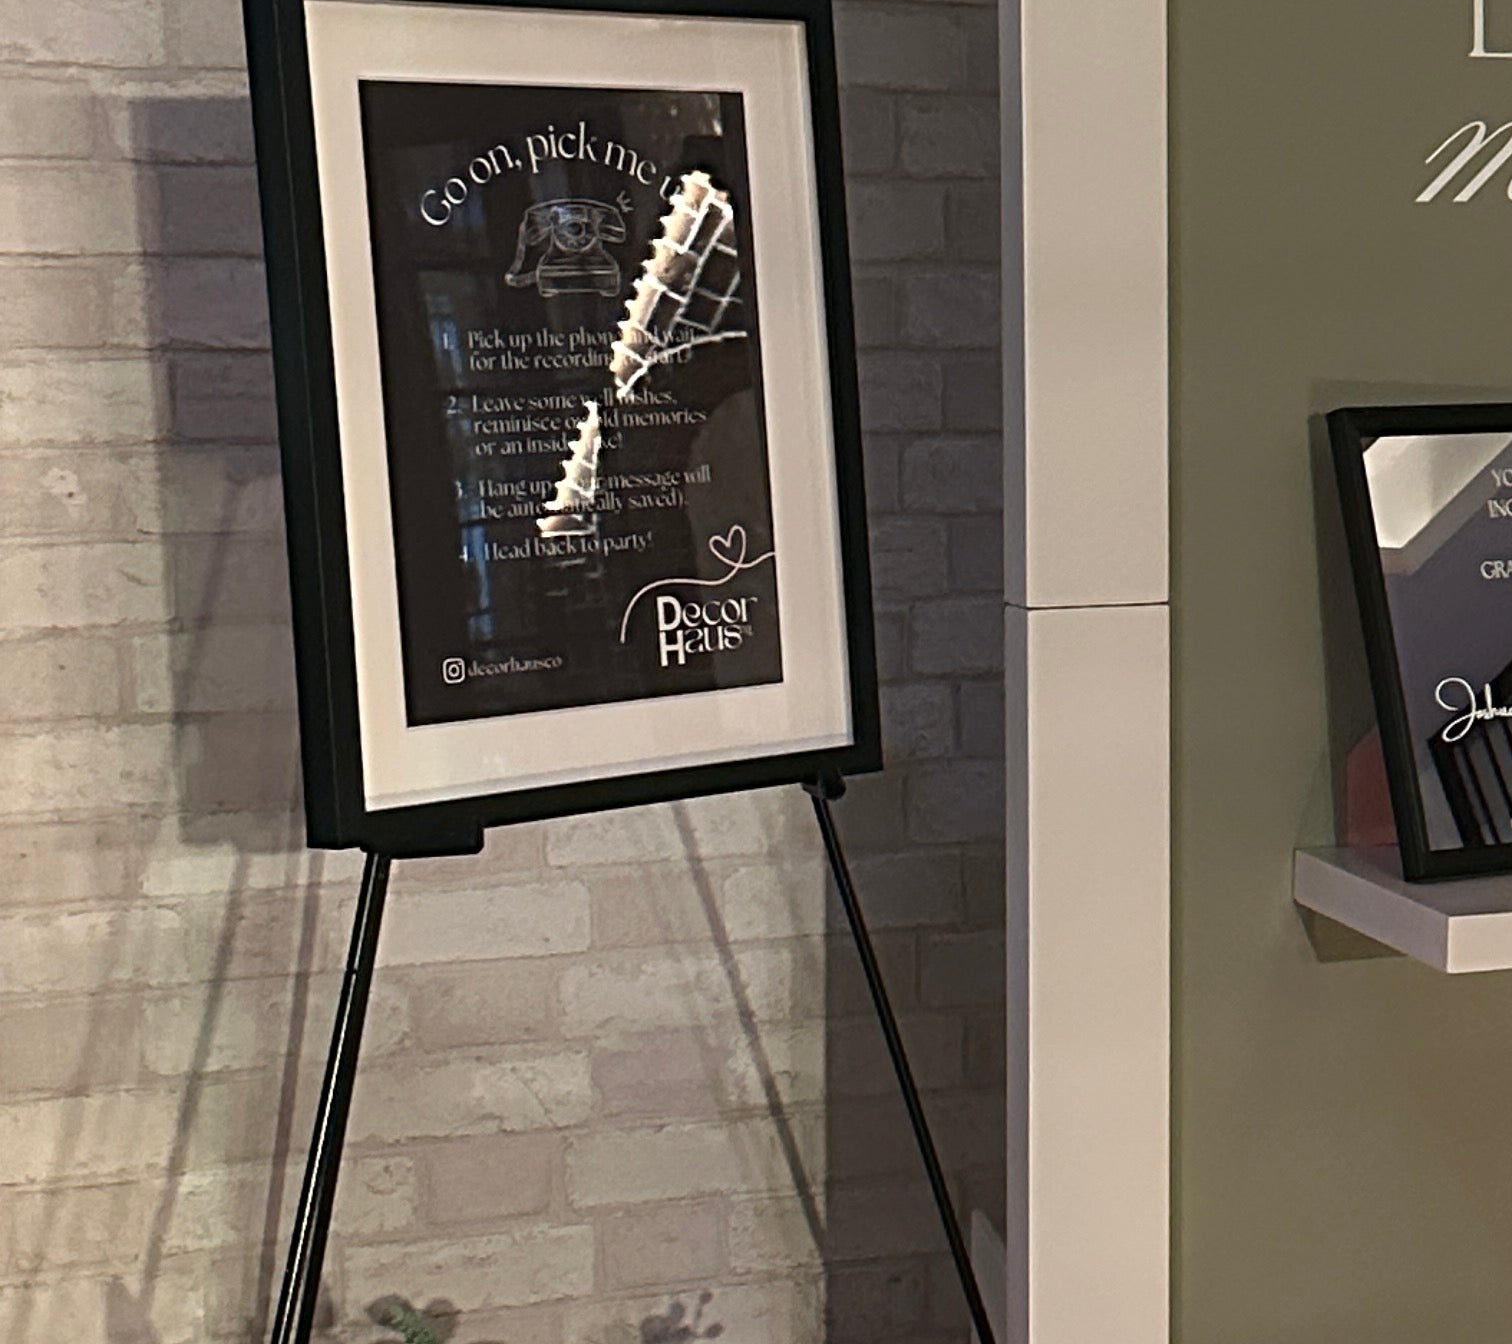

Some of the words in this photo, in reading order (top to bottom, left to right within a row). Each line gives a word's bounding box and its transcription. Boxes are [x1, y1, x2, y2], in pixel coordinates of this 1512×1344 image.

[420, 177, 468, 226] Go
[468, 144, 522, 184] on,
[525, 121, 597, 173] pick
[604, 140, 657, 186] me
[468, 328, 505, 349] Pick
[508, 334, 531, 353] up
[536, 327, 564, 347] the
[568, 326, 620, 352] phon
[470, 350, 496, 370] for
[501, 350, 530, 369] the
[533, 347, 621, 368] recordin
[472, 394, 524, 412] Leave
[527, 393, 577, 411] some
[473, 415, 561, 434] reminisce
[623, 408, 707, 427] memories
[475, 441, 496, 455] or
[500, 440, 523, 455] an
[526, 432, 577, 453] insid
[479, 479, 528, 502] Hang
[529, 479, 552, 500] up
[608, 470, 681, 489] message
[683, 464, 712, 484] will
[481, 499, 503, 519] be
[484, 537, 531, 560] Head
[533, 536, 577, 557] back
[581, 536, 598, 554] to
[600, 531, 653, 557] party!
[656, 595, 758, 631] Decor
[659, 624, 743, 667] Haus
